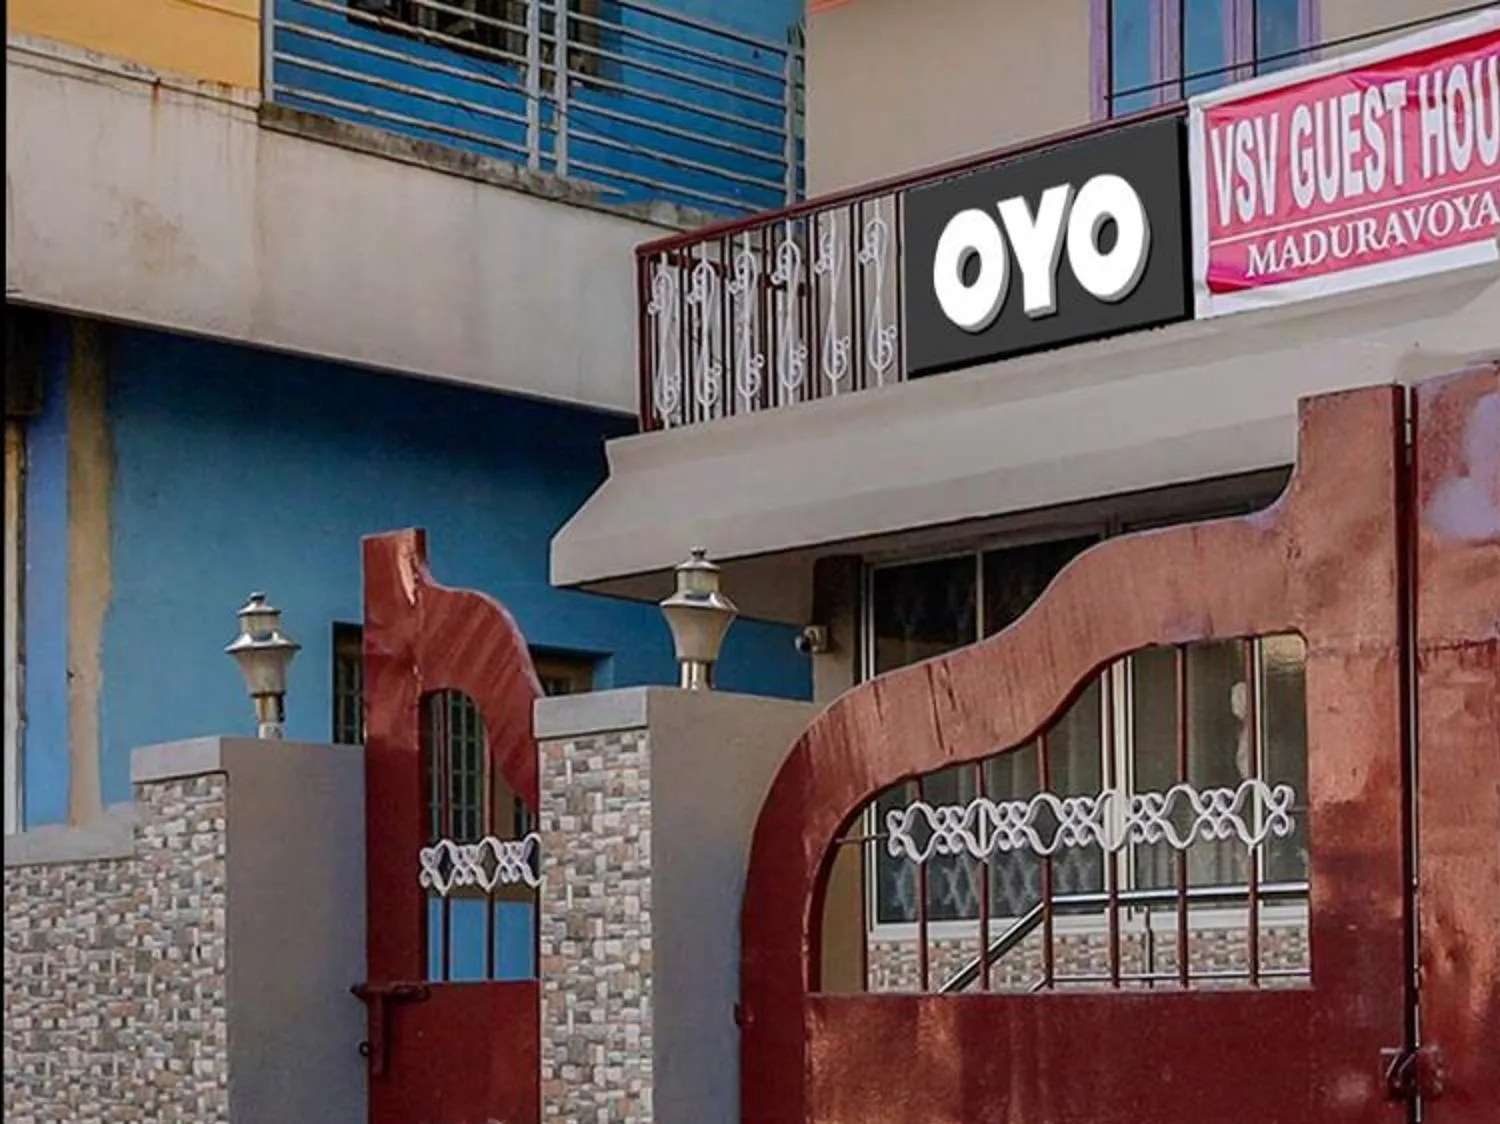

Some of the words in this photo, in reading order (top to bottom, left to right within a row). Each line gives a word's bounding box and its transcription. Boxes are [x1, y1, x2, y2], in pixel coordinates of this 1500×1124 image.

[1211, 112, 1279, 226] VSV
[1290, 80, 1407, 209] GUEST
[933, 174, 1150, 333] OYO
